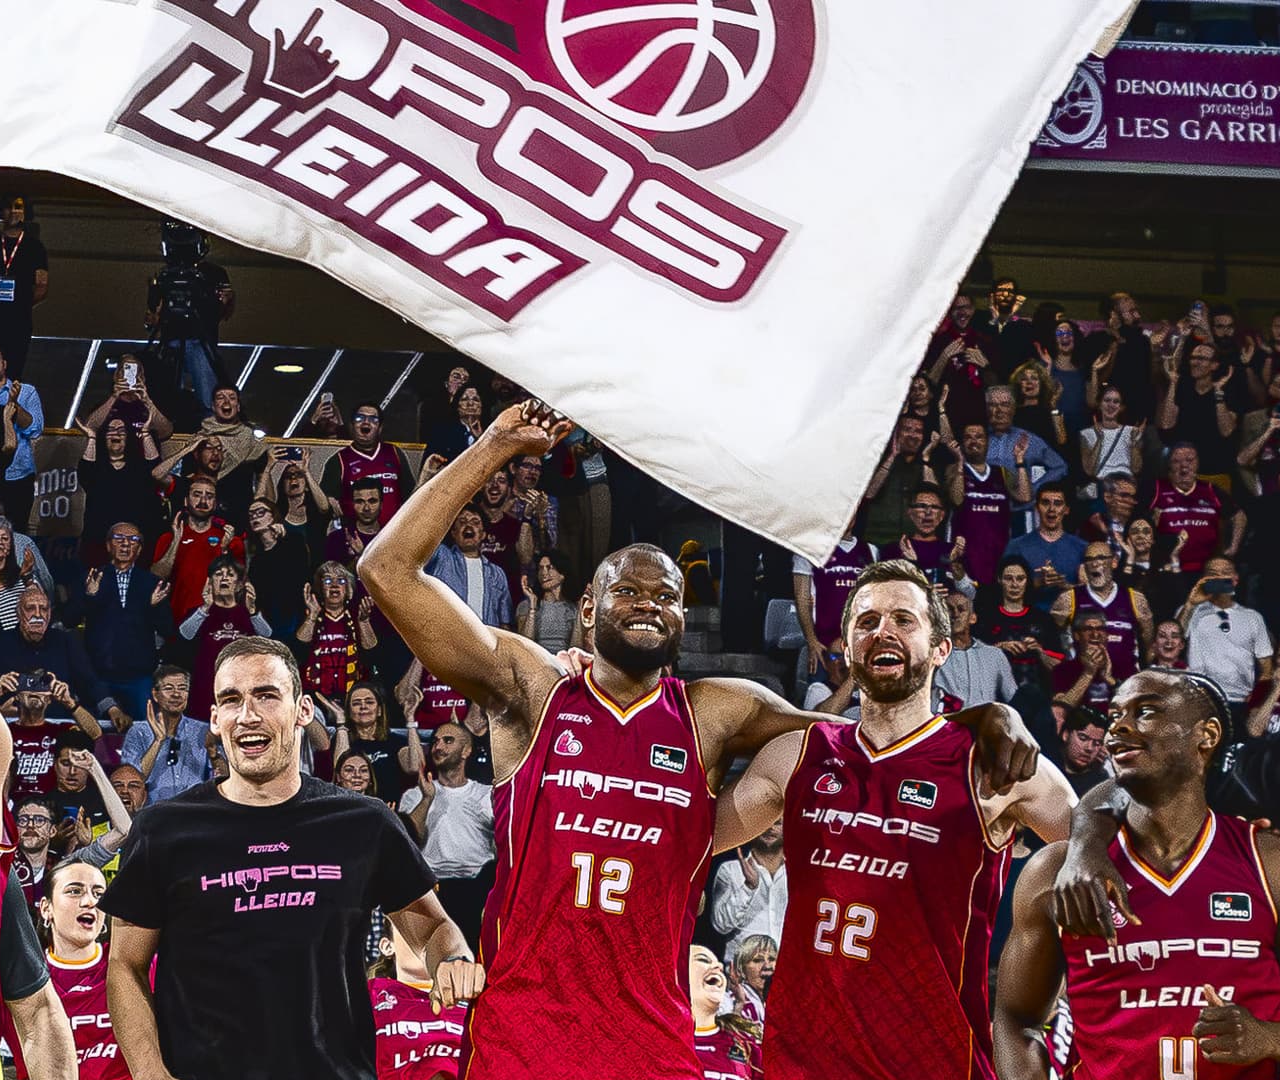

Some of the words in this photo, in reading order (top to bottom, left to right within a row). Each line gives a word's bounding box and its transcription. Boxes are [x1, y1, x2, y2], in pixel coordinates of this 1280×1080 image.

[1116, 79, 1257, 100] DENOMINACIÓ
[1199, 99, 1273, 119] protegida
[1117, 117, 1170, 140] LES
[136, 62, 562, 302] LLEIDA
[541, 768, 692, 808] HIOPOS
[553, 811, 662, 846] LLEIDA
[802, 808, 941, 844] HIOPOS
[201, 864, 342, 893] HIOPOS
[810, 847, 909, 879] LLEIDA
[572, 852, 633, 915] 12
[234, 891, 316, 913] LLEIDA
[814, 898, 877, 962] 22
[1085, 938, 1262, 970] HIOPOS
